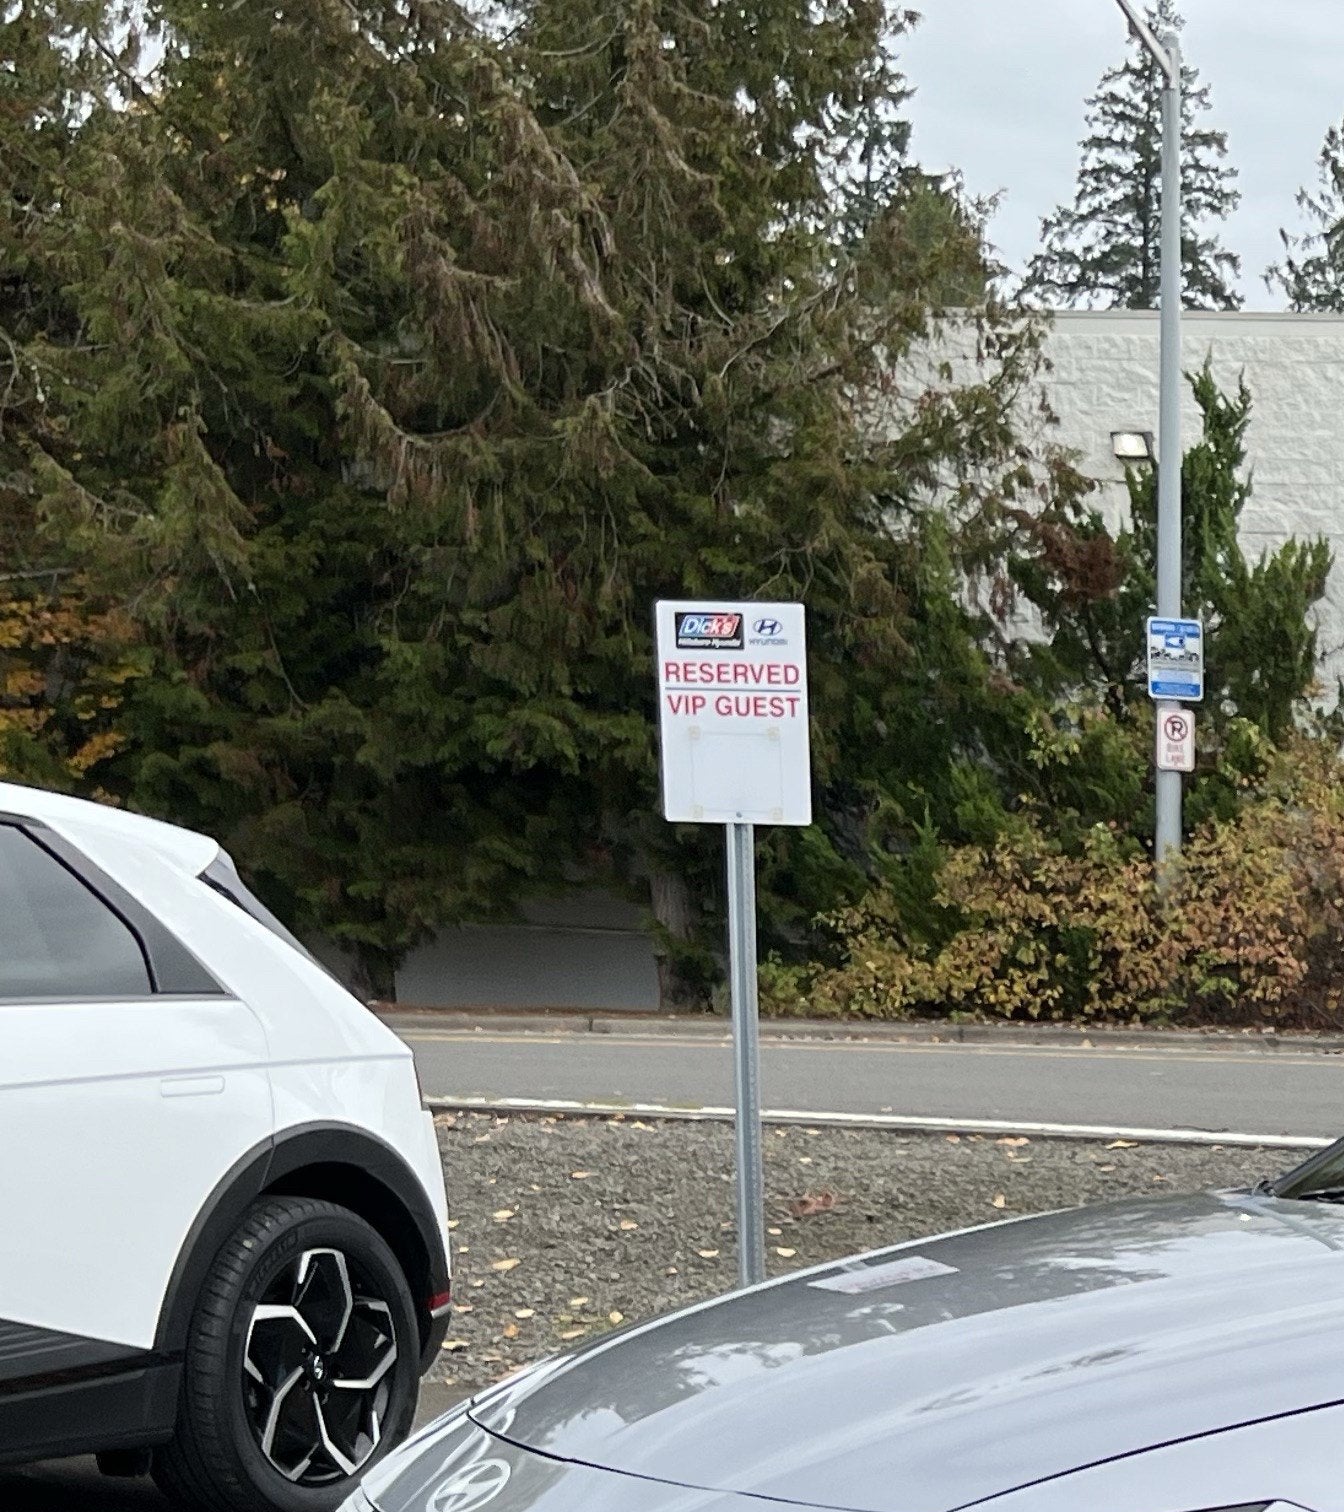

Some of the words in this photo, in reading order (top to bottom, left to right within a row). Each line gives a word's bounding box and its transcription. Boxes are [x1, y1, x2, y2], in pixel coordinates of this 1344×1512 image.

[664, 662, 800, 685] RESERVED
[667, 694, 706, 715] VIP
[714, 695, 801, 718] GUEST
